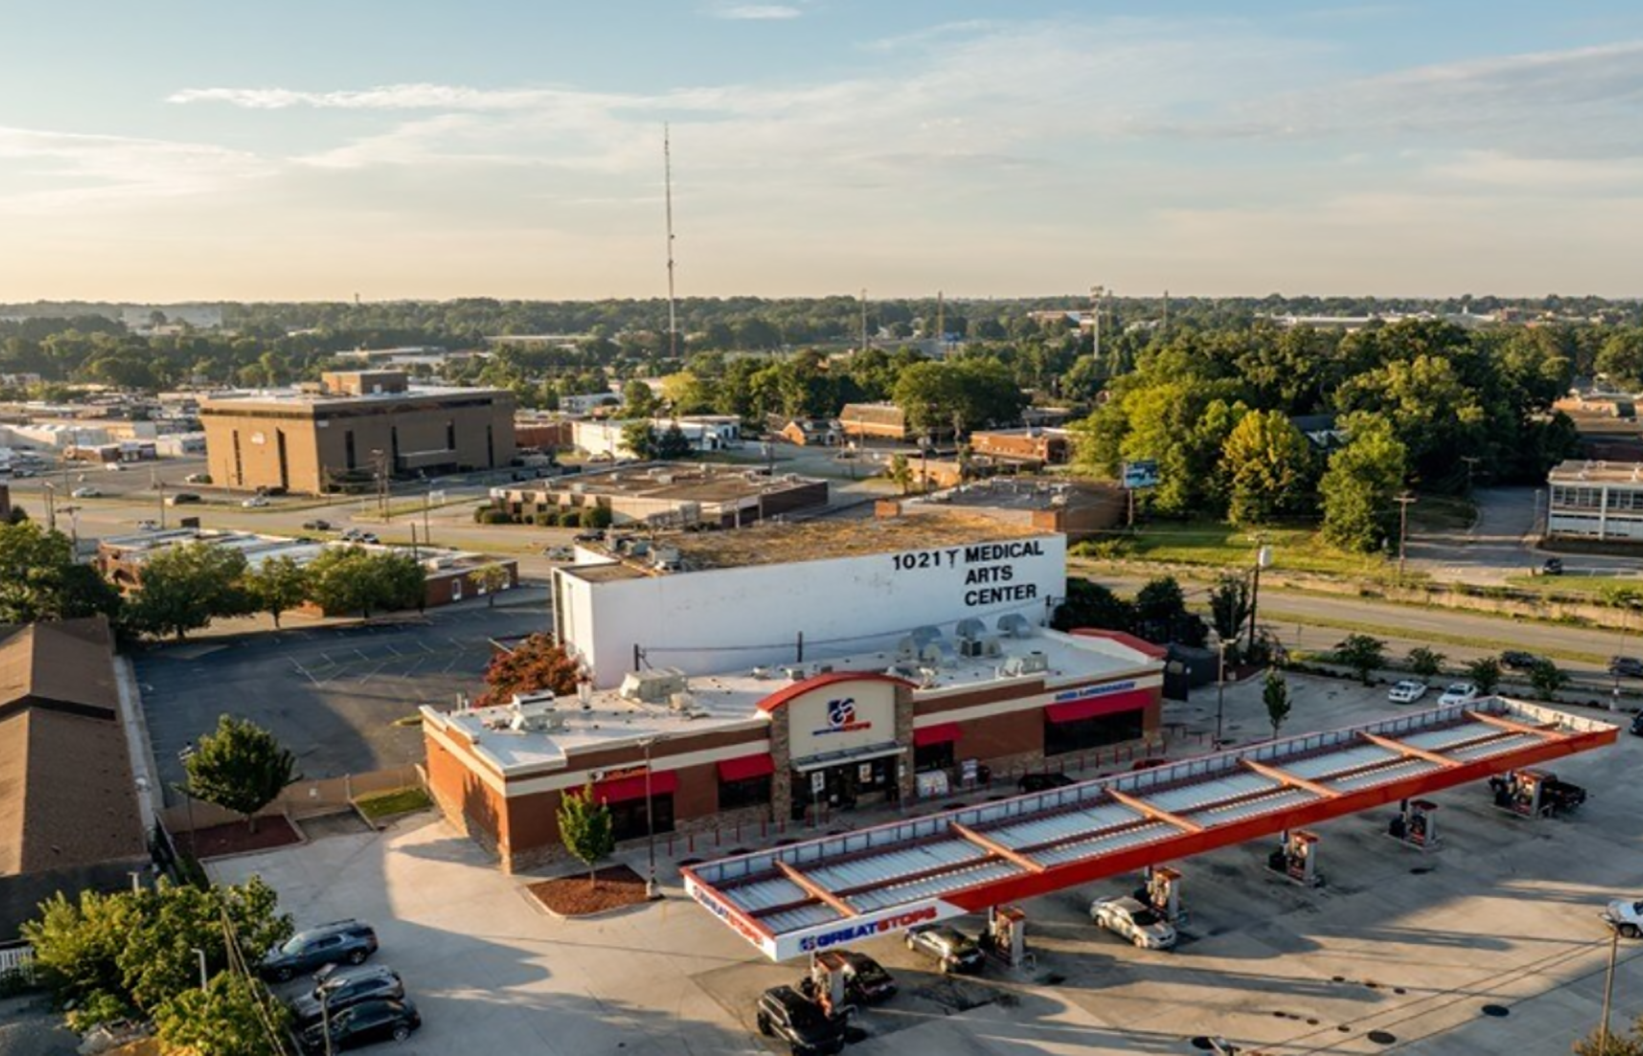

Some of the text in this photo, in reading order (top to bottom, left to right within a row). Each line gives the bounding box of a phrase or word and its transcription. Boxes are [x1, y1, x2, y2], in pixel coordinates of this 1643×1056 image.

[892, 541, 1044, 570] 1021 MEDICAL
[965, 565, 1013, 585] ARTS
[964, 584, 1037, 606] CENTER
